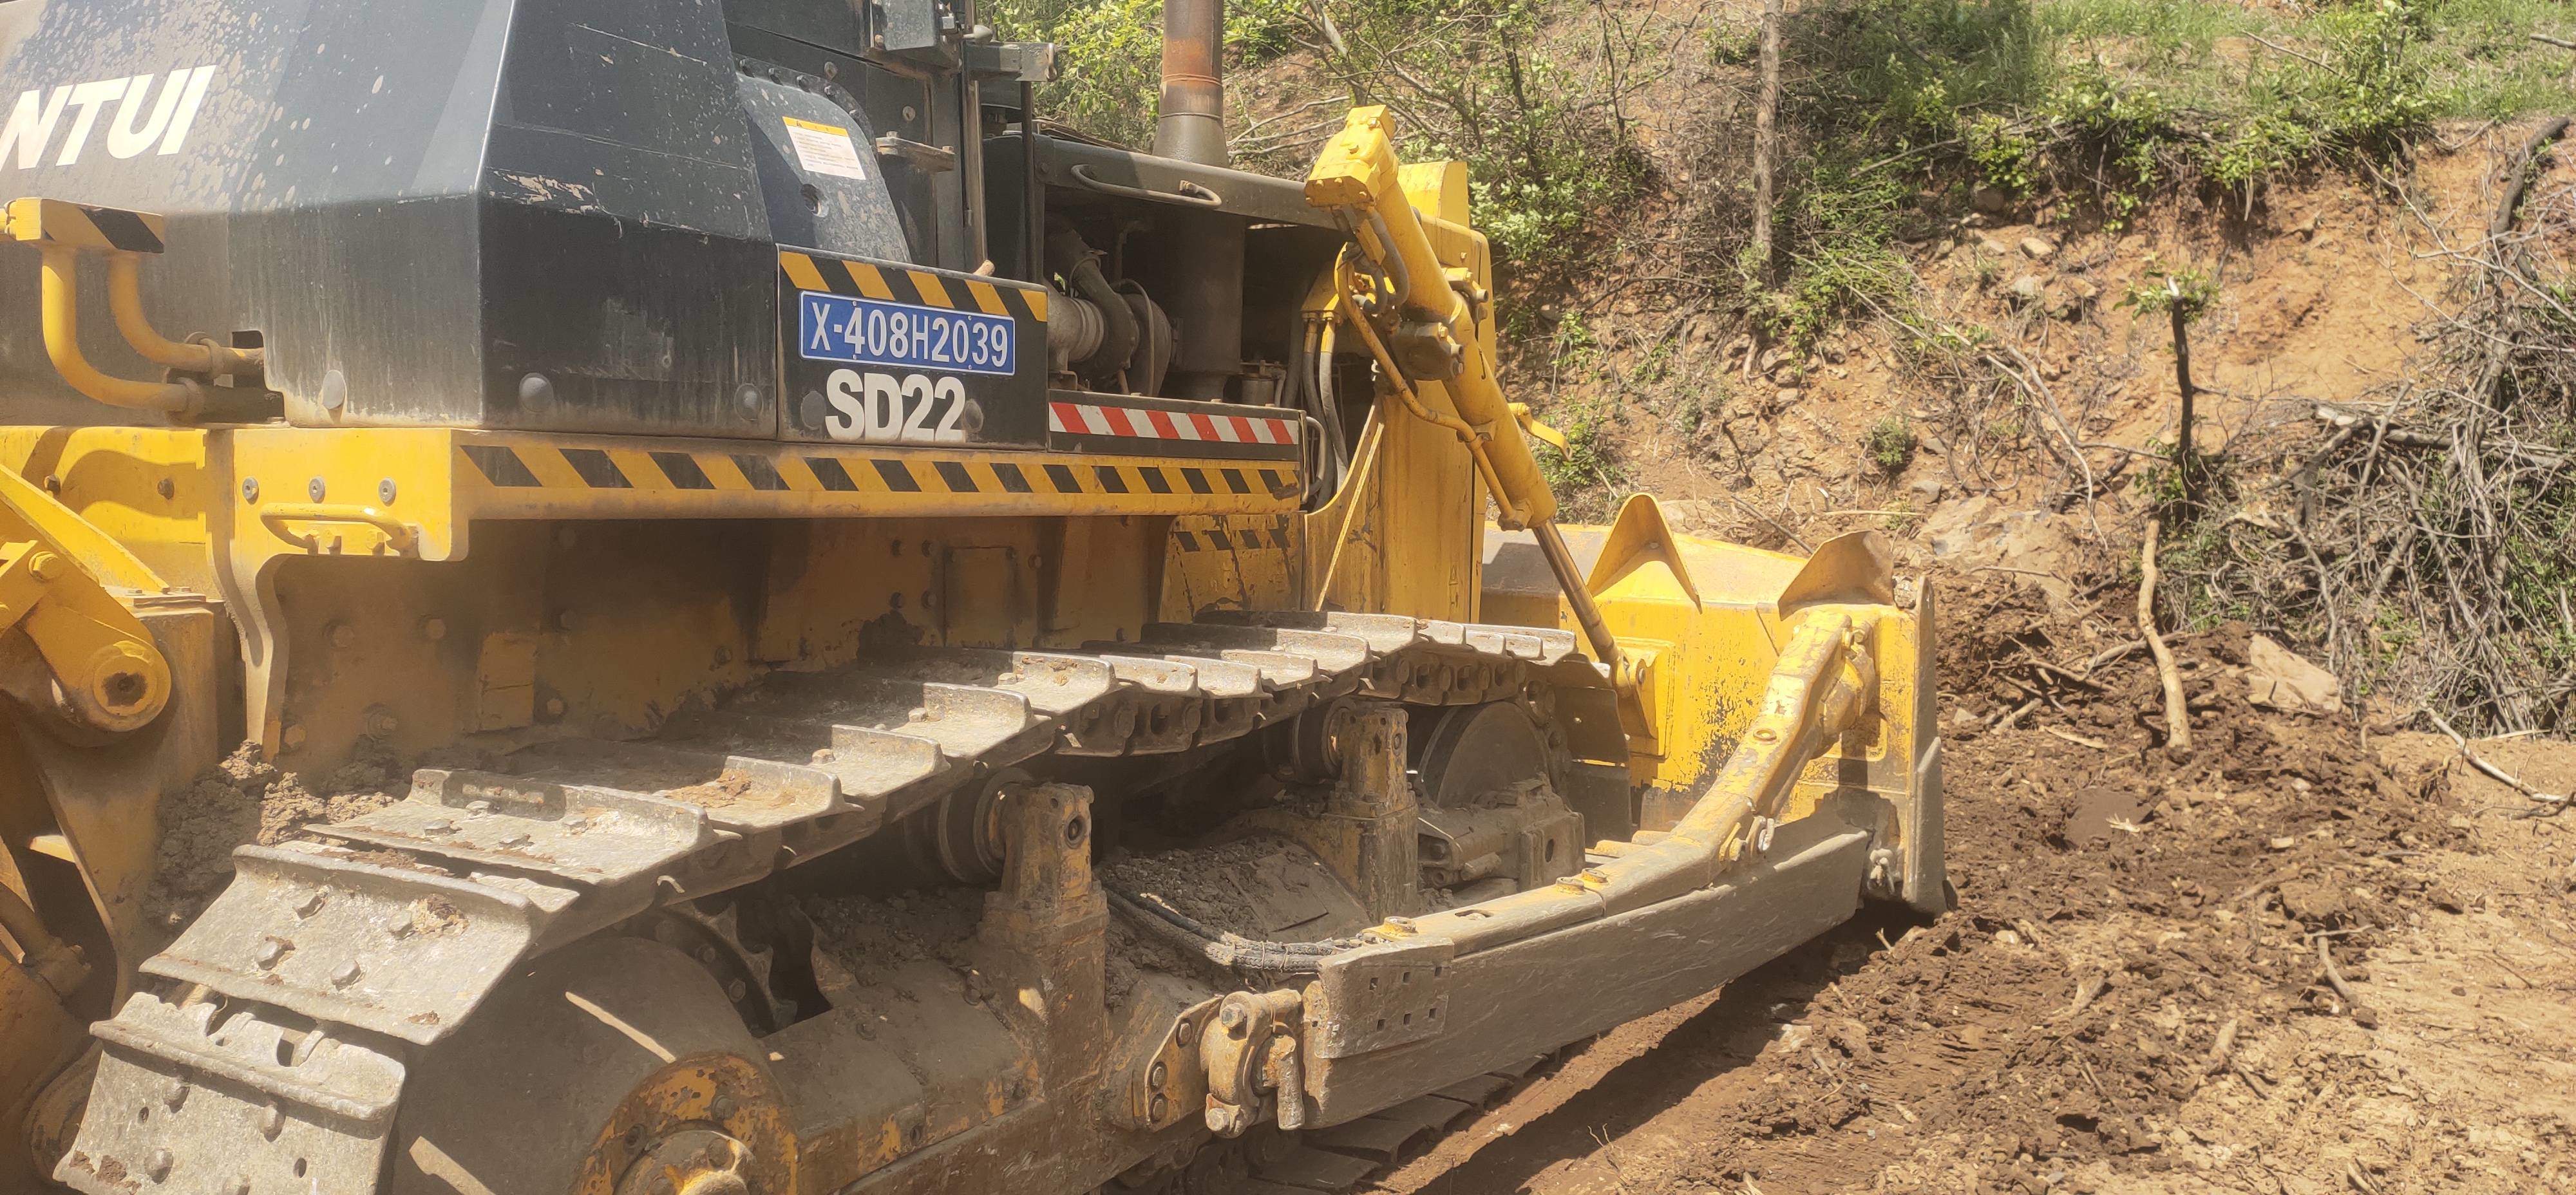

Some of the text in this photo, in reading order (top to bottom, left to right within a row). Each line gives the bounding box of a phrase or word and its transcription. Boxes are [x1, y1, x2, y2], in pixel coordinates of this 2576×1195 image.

[0, 65, 216, 171] NTUI
[811, 302, 1008, 367] X-408H2039
[825, 368, 965, 443] SD22
